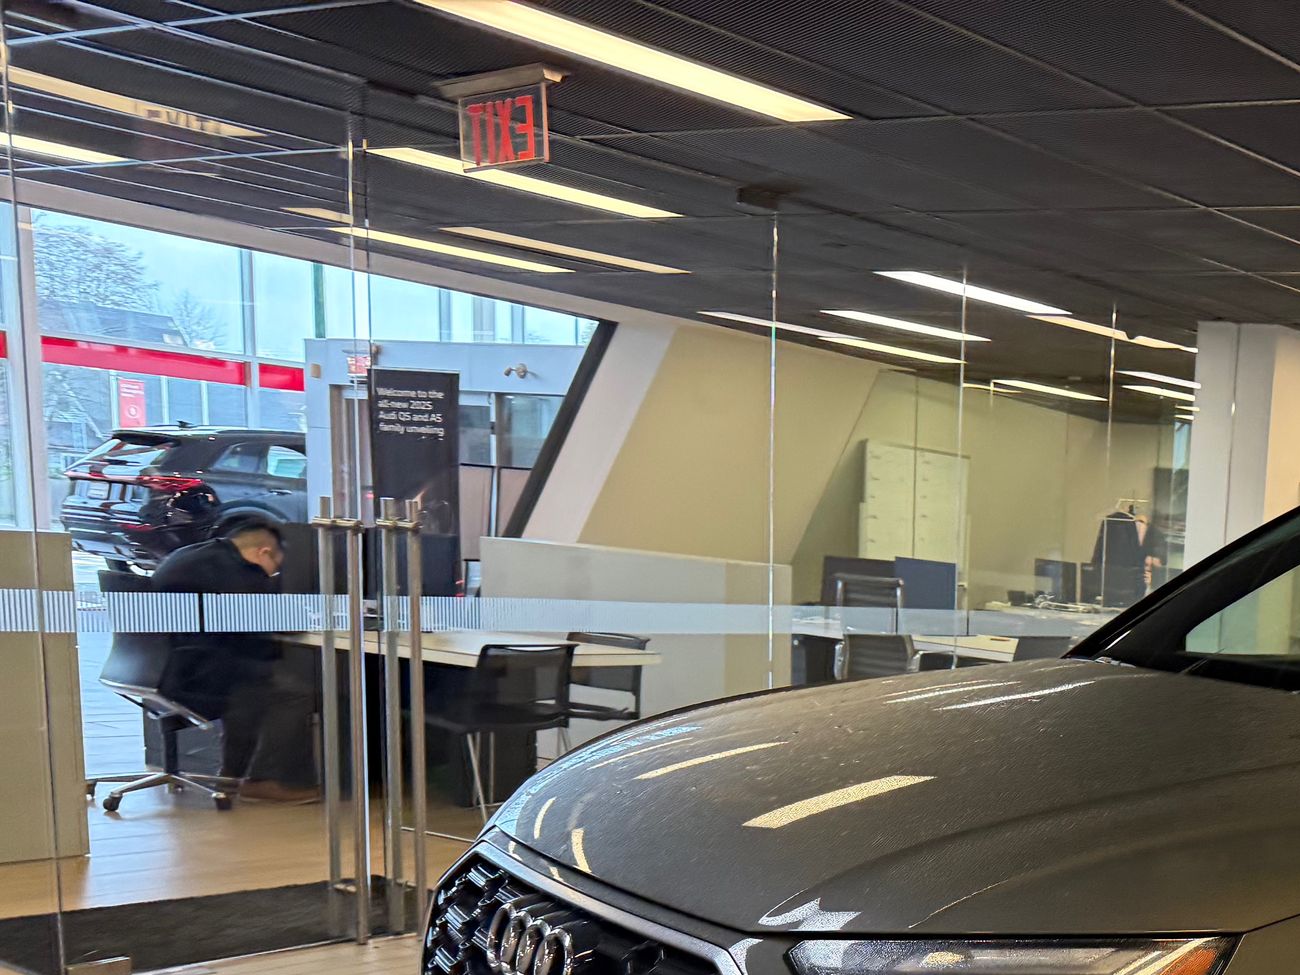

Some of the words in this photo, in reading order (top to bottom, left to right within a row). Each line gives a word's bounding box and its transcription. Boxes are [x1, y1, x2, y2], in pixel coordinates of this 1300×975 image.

[376, 387, 417, 397] Welcome
[417, 390, 428, 398] to
[428, 390, 445, 399] the
[409, 400, 433, 410] 2025
[378, 411, 397, 420] Audi
[398, 411, 412, 422] Q5
[412, 413, 429, 422] and
